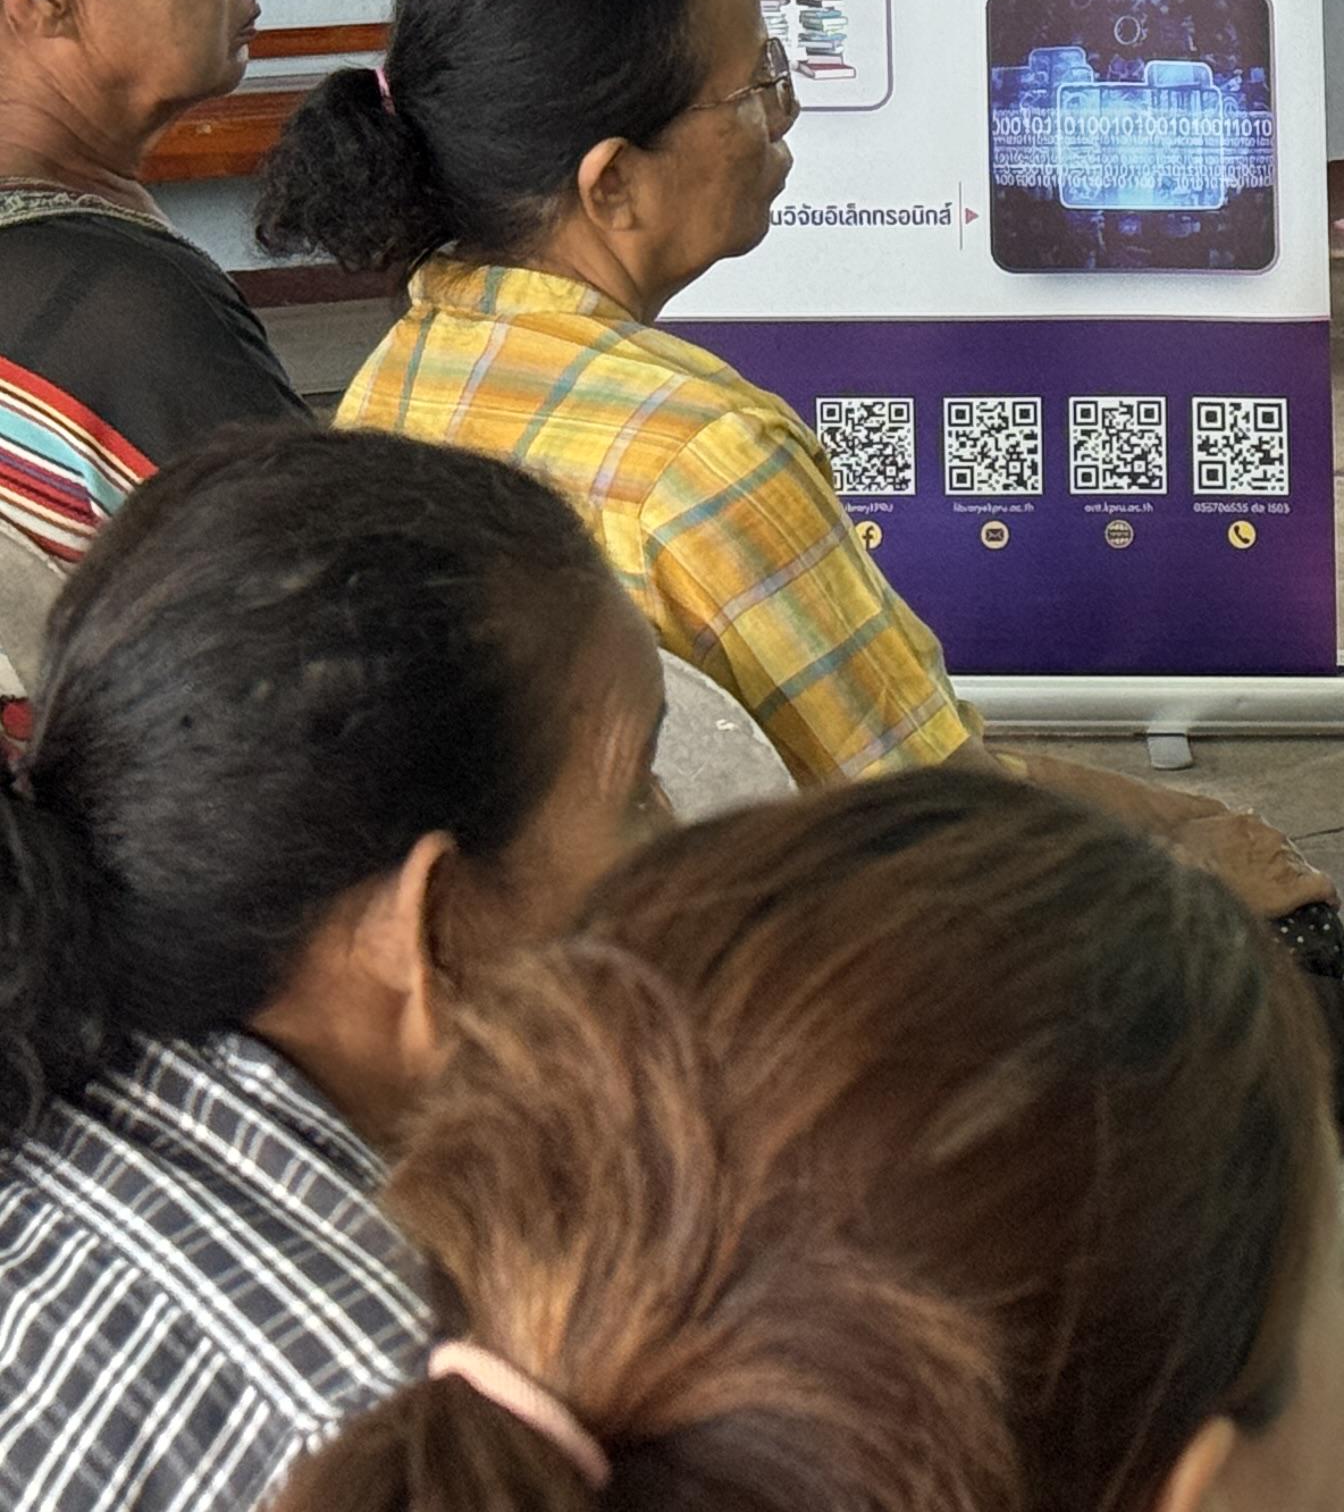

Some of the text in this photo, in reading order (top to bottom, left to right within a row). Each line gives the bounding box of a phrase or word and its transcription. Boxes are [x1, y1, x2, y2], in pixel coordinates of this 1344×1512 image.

[769, 202, 953, 226] นวิจัยอิเล็กทรอนิกส์
